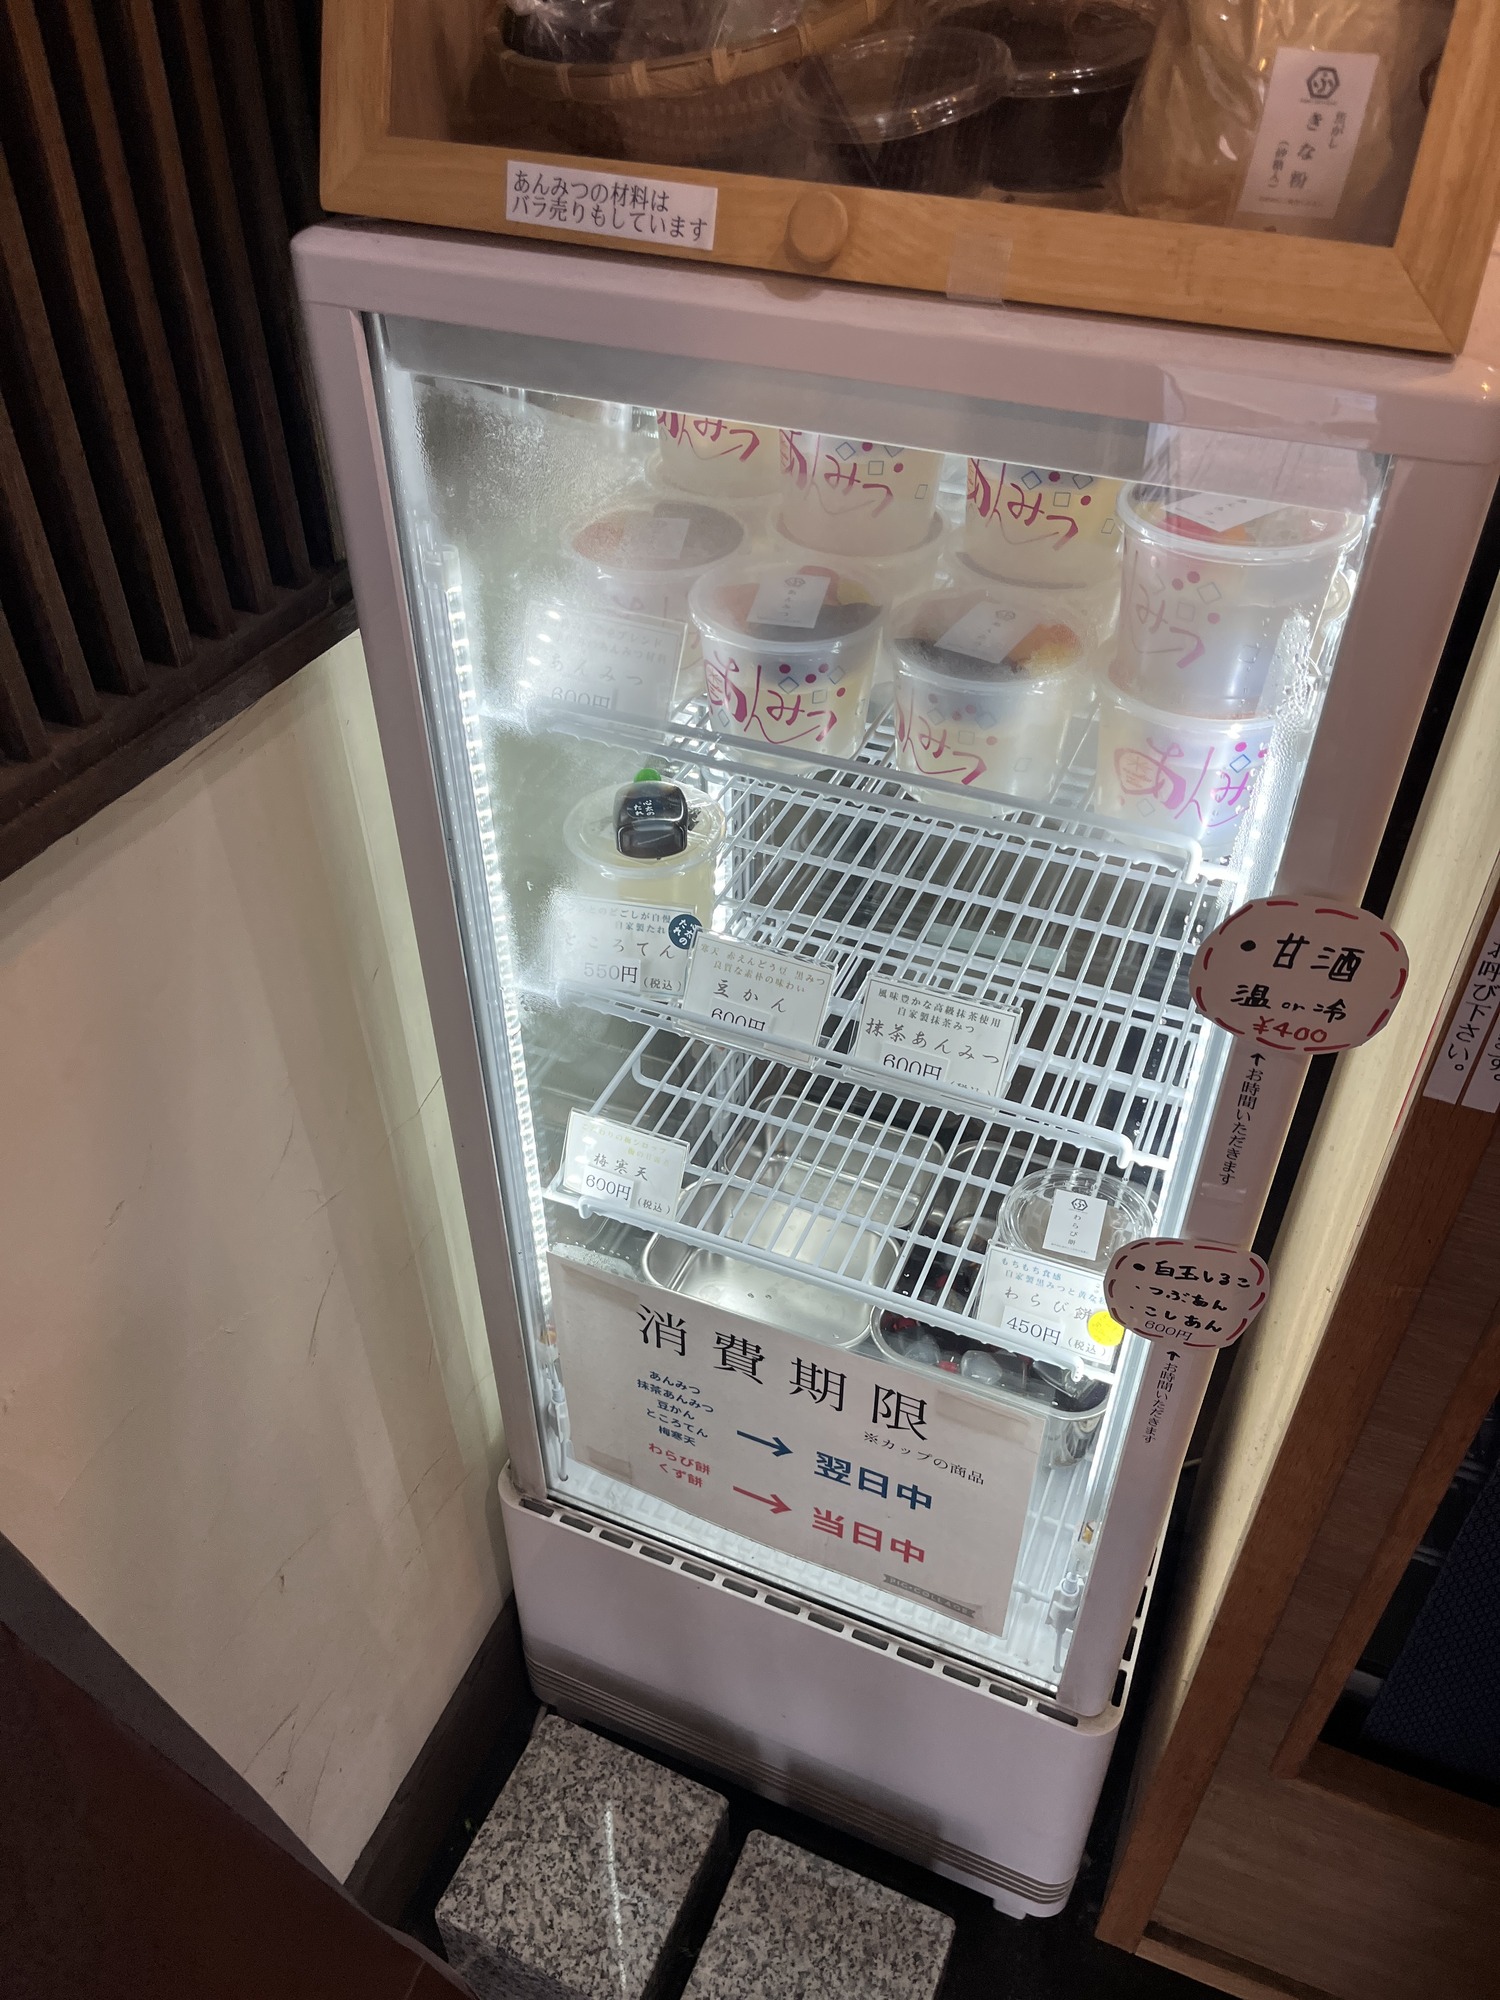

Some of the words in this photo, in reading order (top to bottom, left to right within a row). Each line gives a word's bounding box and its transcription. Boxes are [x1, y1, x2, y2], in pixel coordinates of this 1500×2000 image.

[514, 170, 670, 212] あんみつの材料は
[512, 196, 708, 241] バラ売りもしています
[704, 651, 837, 745] あんみつ
[562, 931, 675, 960] ところてん
[1273, 933, 1365, 982] 甘酒
[584, 962, 638, 984] 550円
[713, 979, 787, 1014] 豆かん
[878, 988, 1002, 1028] 風味豊かな高級抹茶使用
[1230, 983, 1272, 1010] 温
[1281, 1001, 1305, 1012] or
[1312, 998, 1347, 1024] 冷
[897, 1007, 975, 1033] 自家製抹茶みつ
[1252, 1015, 1328, 1043] ¥400
[866, 1018, 1000, 1064] 抹茶あんみつ
[1219, 1067, 1264, 1186] お時間いただきます
[593, 1152, 648, 1181] 梅寒天
[585, 1174, 632, 1201] 600円
[1002, 1257, 1062, 1281] もちもち食感
[1155, 1260, 1250, 1288] 白玉しるこ
[1005, 1286, 1092, 1321] わらび餅
[1149, 1286, 1228, 1312] つぶあん
[1006, 1316, 1062, 1346] 450円
[1145, 1305, 1223, 1333] こしあん
[636, 1304, 928, 1441] 消費期限
[649, 1370, 701, 1395] あんみつ
[636, 1378, 714, 1413] 抹茶あんみつ
[657, 1399, 695, 1421] 豆かん
[1142, 1362, 1178, 1444] お時間いただきます
[646, 1408, 709, 1438] ところてん
[658, 1425, 697, 1447] 梅寒天
[648, 1442, 711, 1476] わらび餅
[659, 1462, 704, 1488] くず餅
[814, 1451, 932, 1510] 翌日中
[812, 1506, 925, 1564] 当日中
